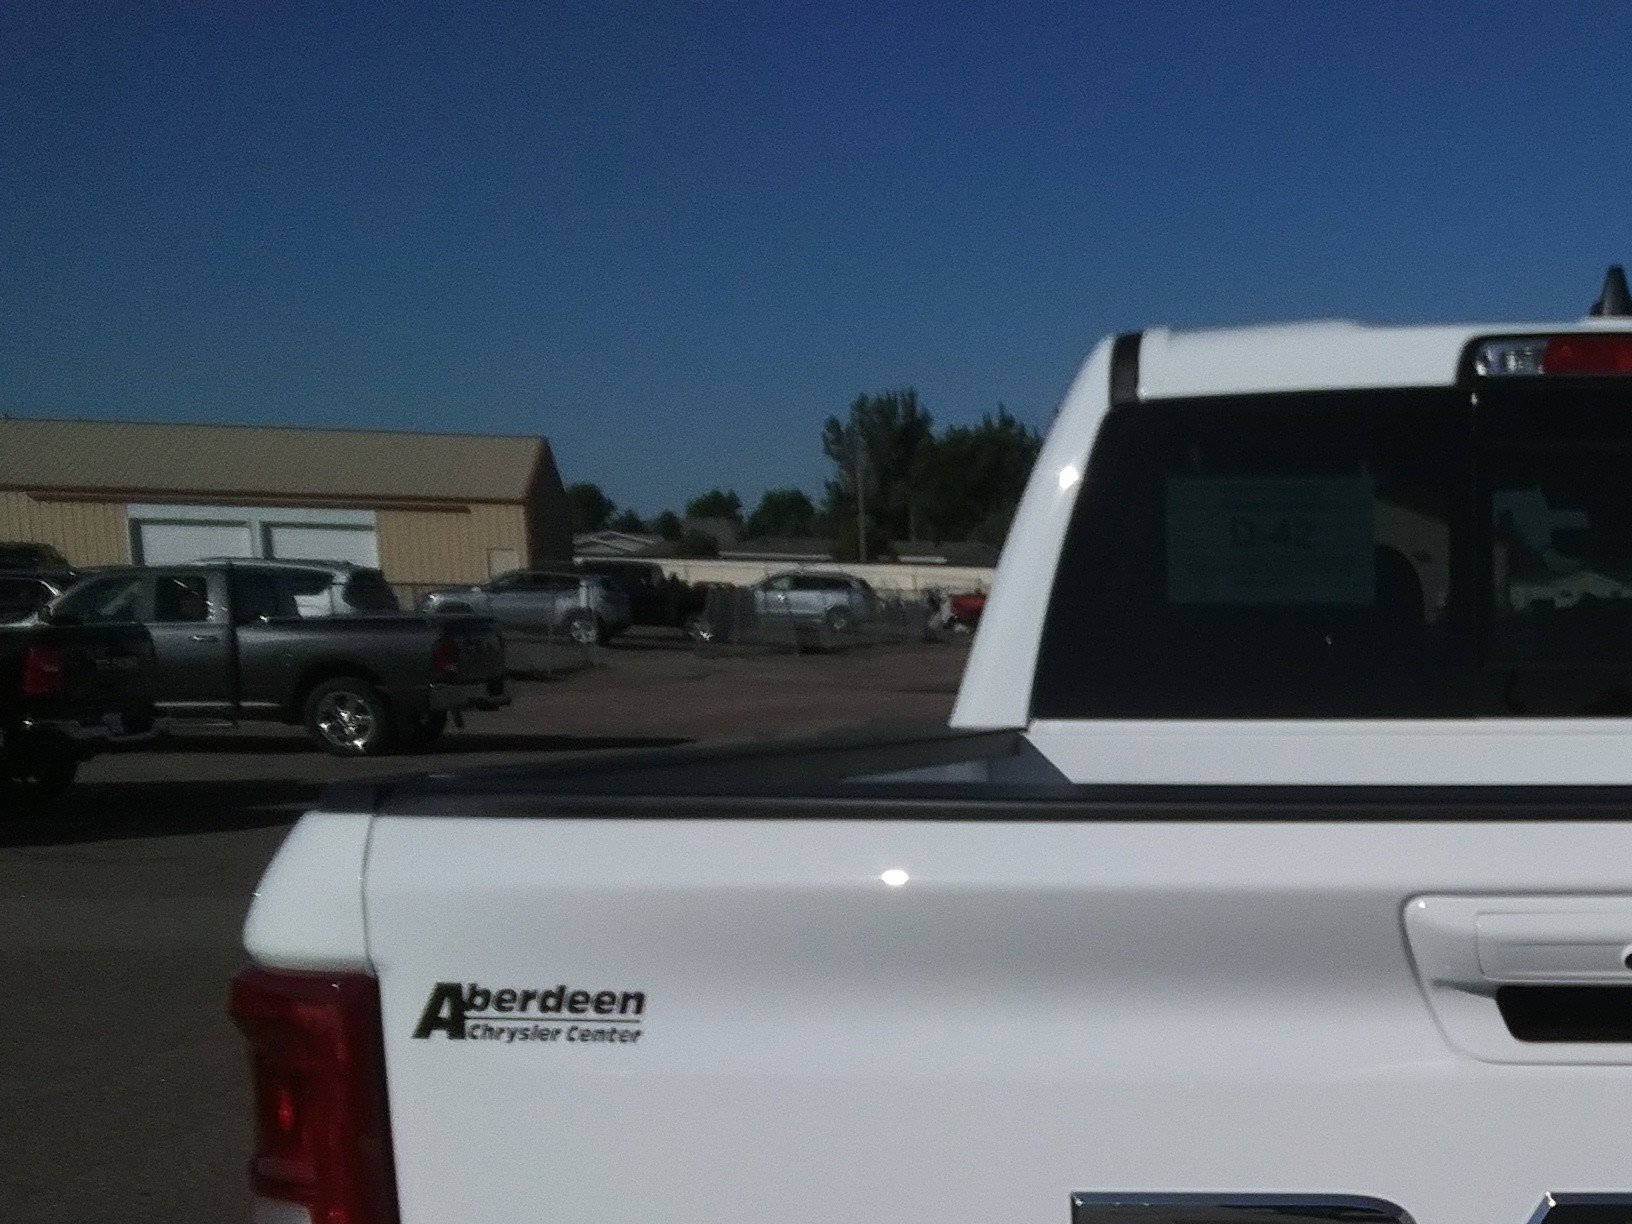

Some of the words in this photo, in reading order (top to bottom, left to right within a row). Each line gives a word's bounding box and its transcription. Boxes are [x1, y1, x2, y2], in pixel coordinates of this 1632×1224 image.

[411, 981, 646, 1040] Aberdeen
[466, 1023, 562, 1043] Chrysler
[565, 1025, 642, 1044] Center
